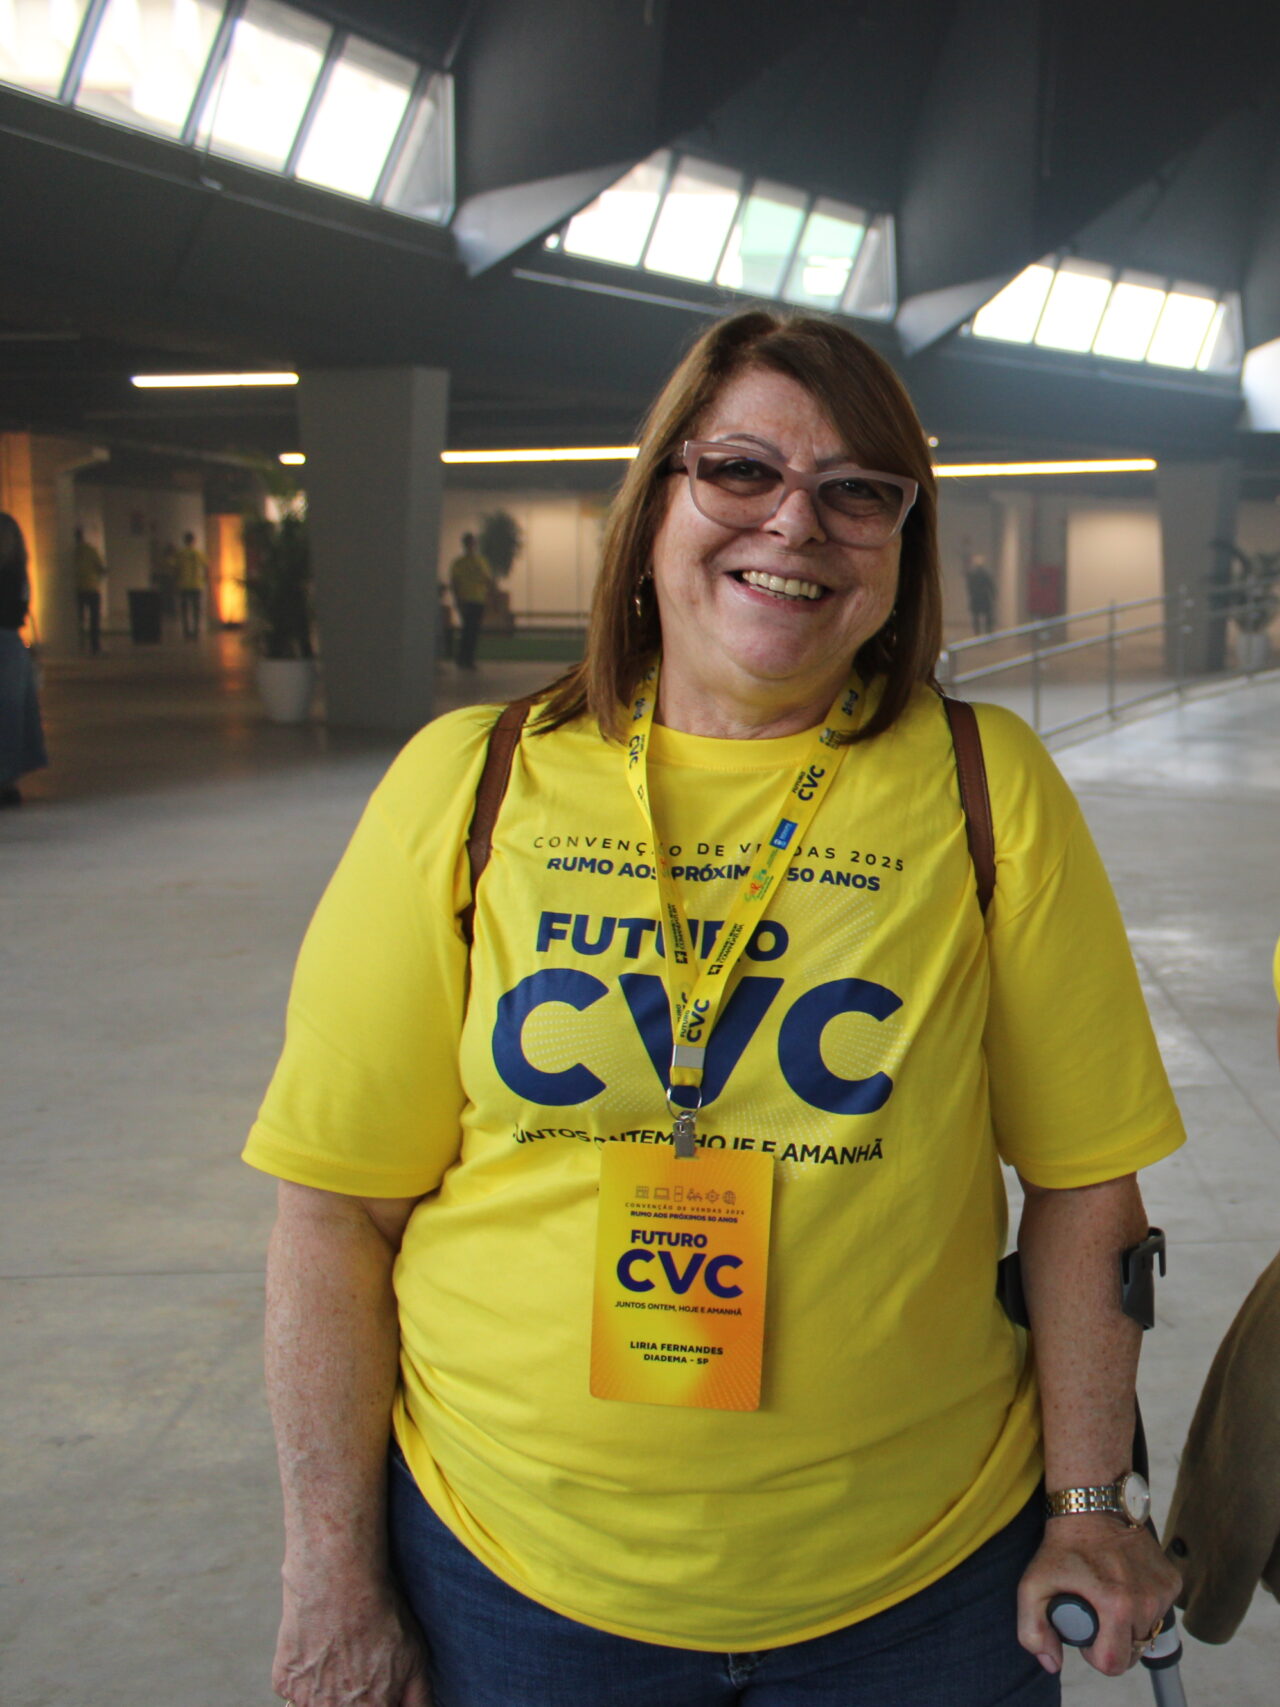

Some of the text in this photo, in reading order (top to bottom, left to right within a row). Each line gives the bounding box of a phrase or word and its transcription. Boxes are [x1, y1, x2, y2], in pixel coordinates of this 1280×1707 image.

[797, 765, 826, 801] CVC
[533, 836, 682, 857] CONVENÇO
[697, 843, 725, 857] DE
[740, 843, 836, 860] VDAS
[851, 851, 904, 872] 2025
[547, 857, 613, 876] RUMO
[671, 863, 751, 882] PRÓXIM
[786, 868, 815, 882] 50
[819, 870, 881, 891] ANOS
[686, 998, 711, 1043] CVC
[491, 967, 904, 1115] CVC
[781, 1138, 883, 1165] AMANHÃ
[625, 1202, 673, 1210] CONVENÇÃO
[669, 1213, 706, 1221] PRÓXIMOS
[630, 1229, 708, 1248] FUTURO
[616, 1249, 744, 1299] CVC
[615, 1301, 646, 1309] JUNTOS
[648, 1303, 677, 1312] ONTEM,
[679, 1305, 699, 1313] HOJE
[707, 1307, 743, 1316] AMANHÃ
[630, 1341, 724, 1355] LIRIA FERNANDES
[643, 1354, 687, 1364] DIADEMA
